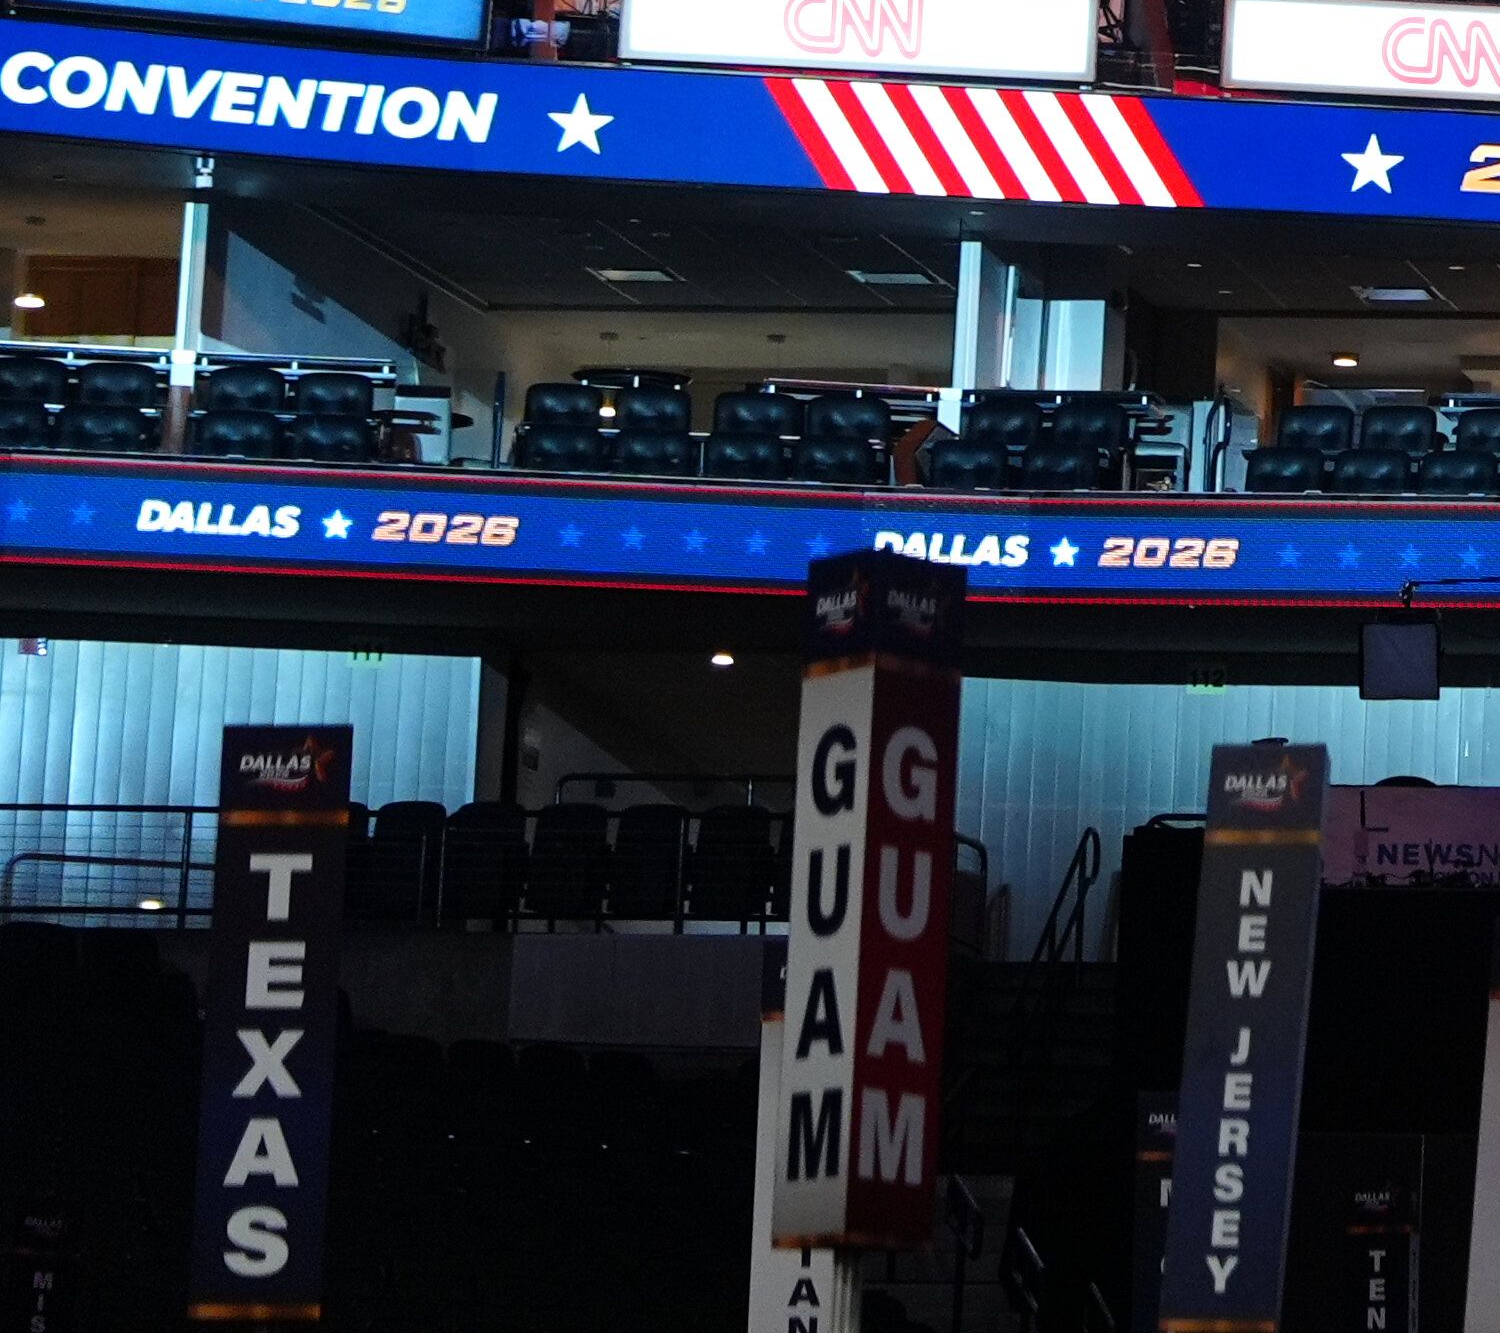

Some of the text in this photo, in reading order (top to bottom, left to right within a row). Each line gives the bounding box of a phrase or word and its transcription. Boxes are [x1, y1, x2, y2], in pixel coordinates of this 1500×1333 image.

[0, 51, 498, 143] CONVENTION
[137, 500, 519, 545] DALLAS 2026
[1098, 537, 1239, 568] 2026
[239, 753, 311, 771] DALLAS
[1224, 774, 1287, 791] DALLAS
[787, 724, 857, 1181] GUAM
[857, 725, 939, 1187] GUAM
[1226, 869, 1272, 999] NEW
[223, 852, 315, 1278] TEXAS
[1206, 1027, 1254, 1294] JERSEY
[1365, 1249, 1387, 1331] TEN
